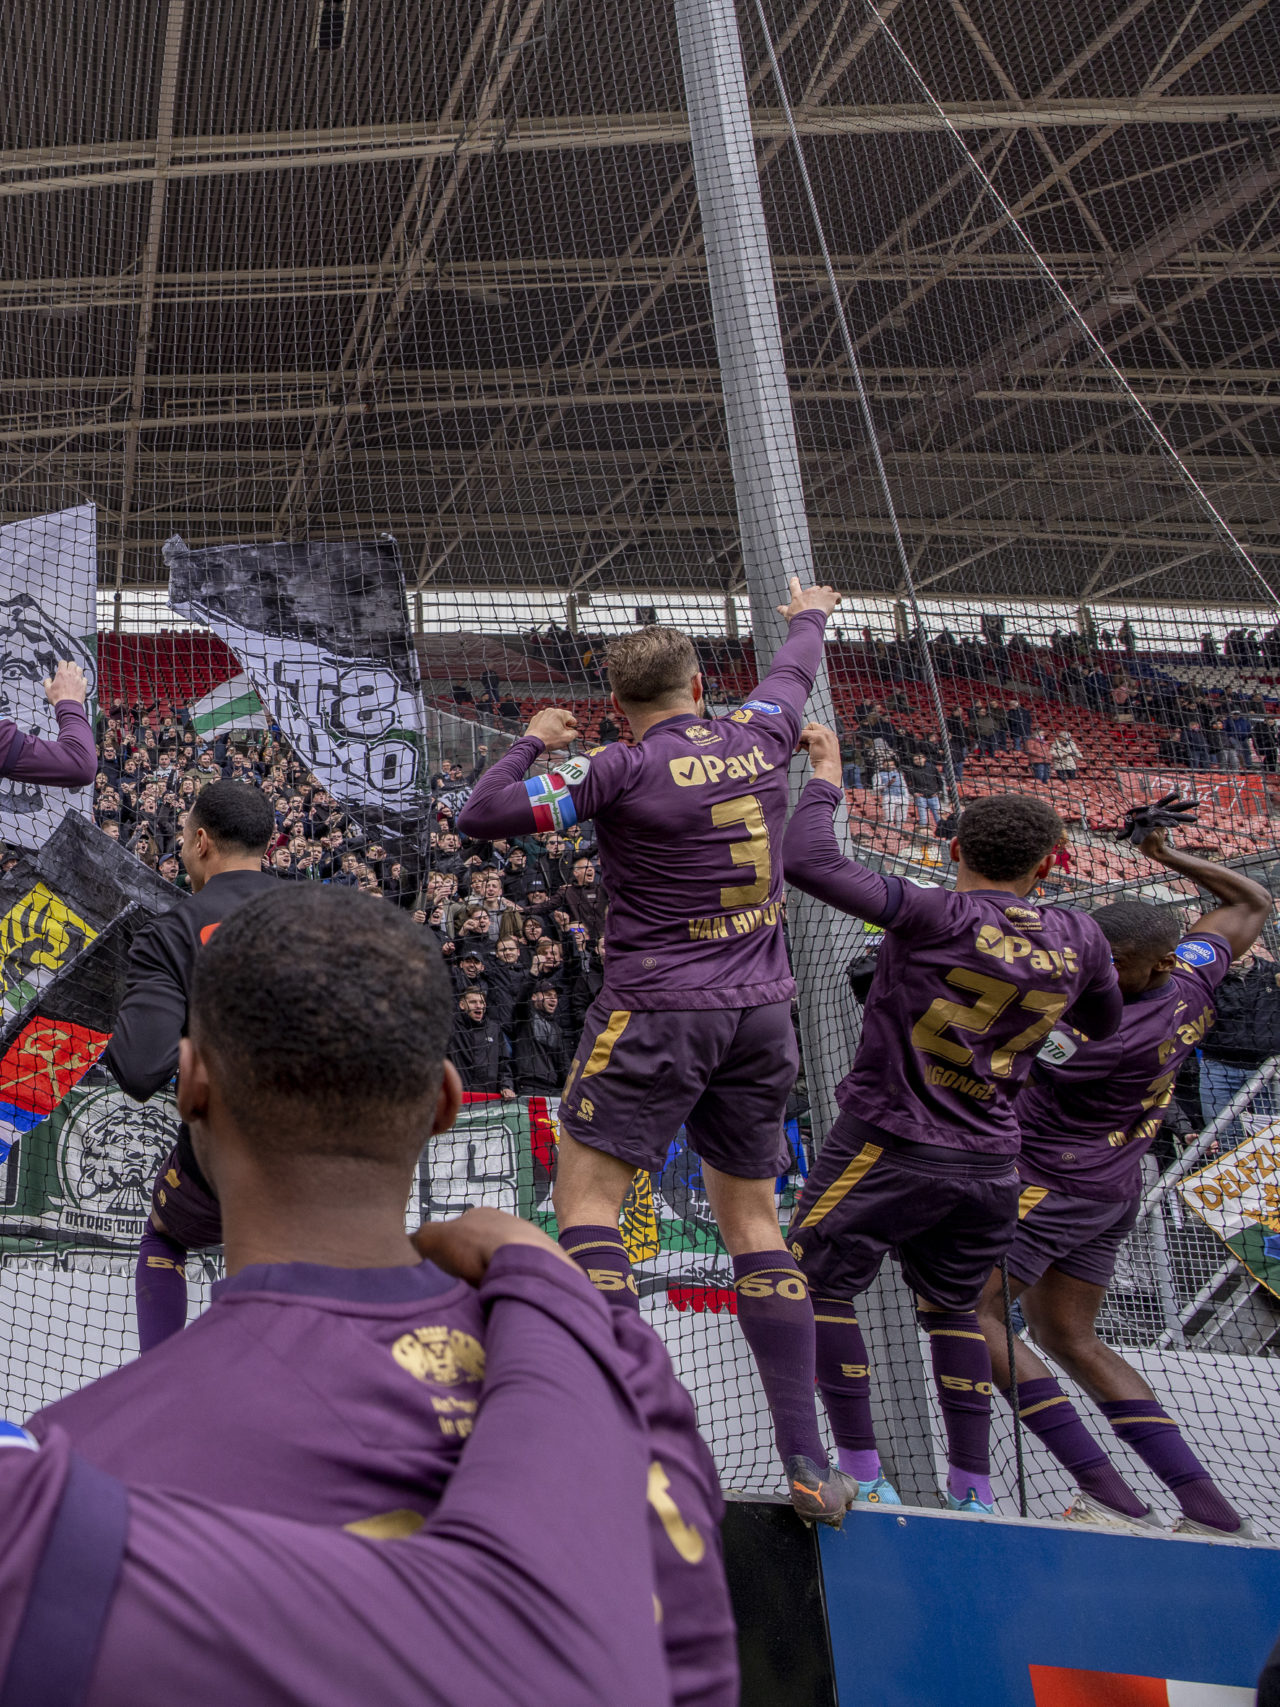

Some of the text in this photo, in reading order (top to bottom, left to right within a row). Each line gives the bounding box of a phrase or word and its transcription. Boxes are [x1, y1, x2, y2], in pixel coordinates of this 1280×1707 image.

[556, 763, 585, 780] OTO
[701, 745, 775, 785] Payt
[711, 794, 772, 910] 3
[688, 917, 729, 940] VAN
[1004, 936, 1079, 979] Payt
[912, 967, 1068, 1078] 27
[1043, 1039, 1067, 1060] OTO
[1192, 1144, 1280, 1211] DELFZI
[738, 1277, 807, 1301] 50
